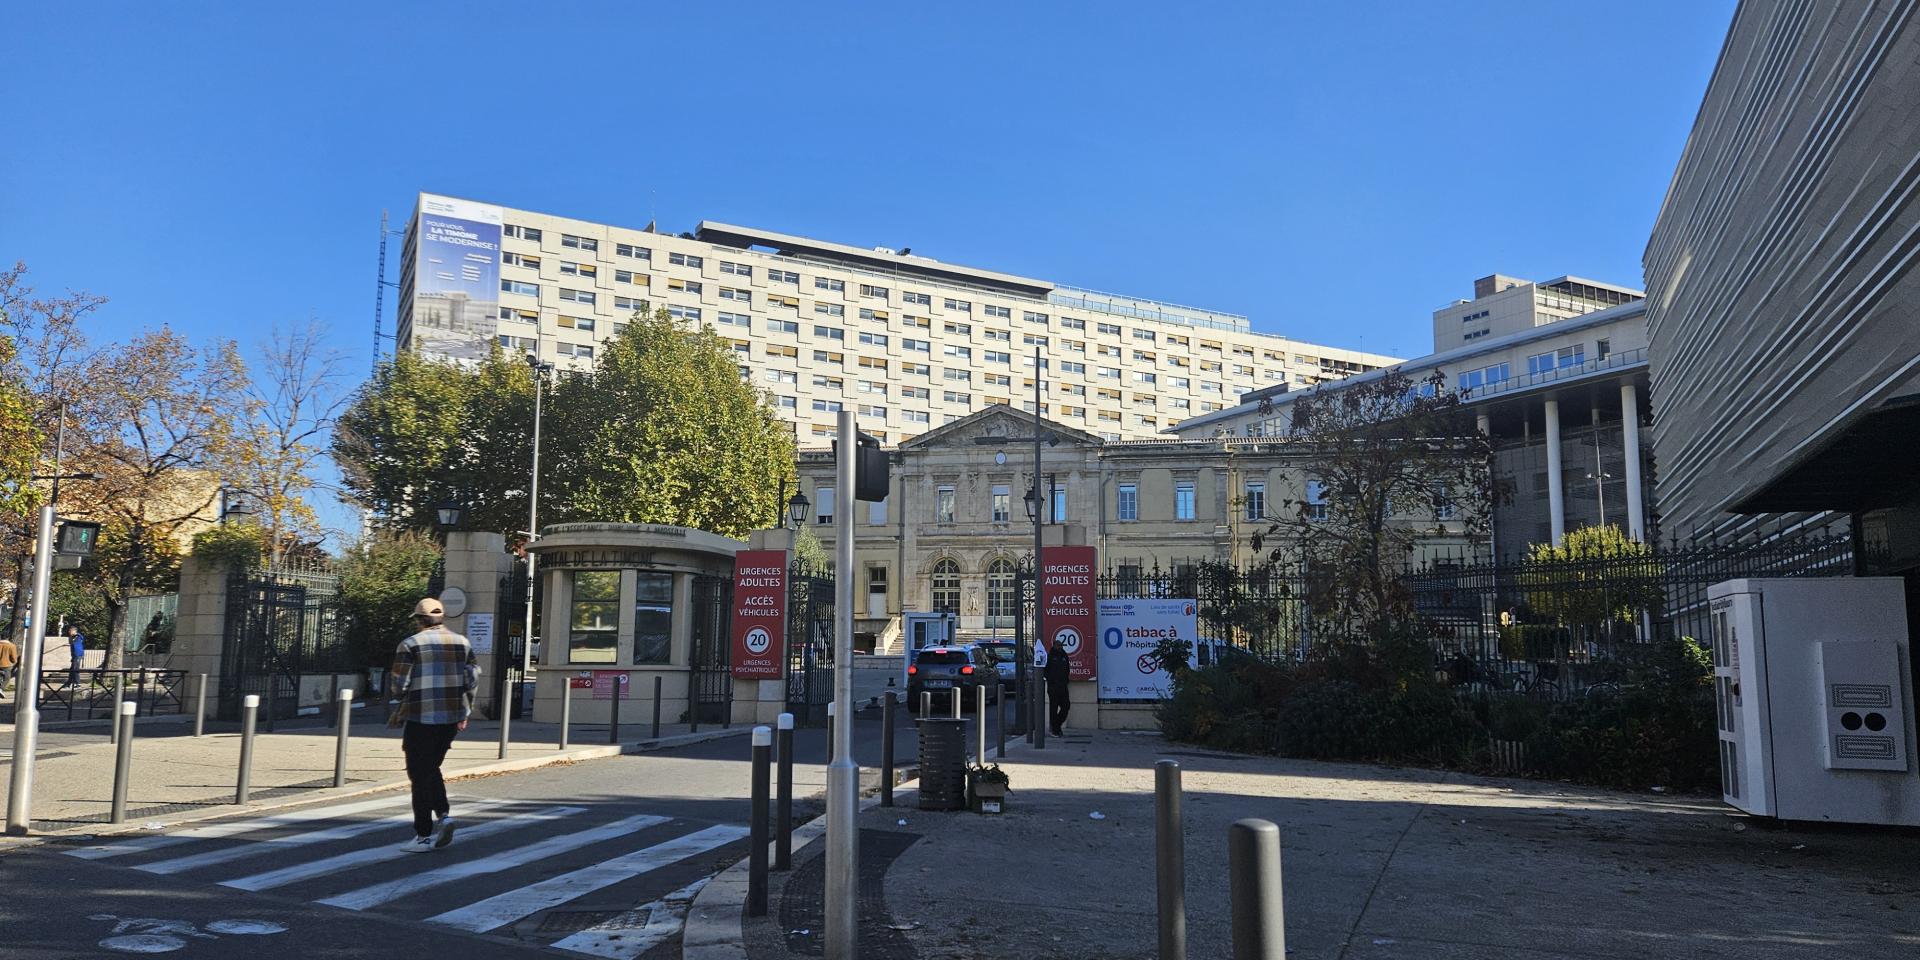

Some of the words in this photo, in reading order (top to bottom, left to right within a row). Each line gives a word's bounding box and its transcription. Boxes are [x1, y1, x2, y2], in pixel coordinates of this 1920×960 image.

[444, 229, 479, 240] TIMONE
[426, 233, 438, 241] SE
[439, 235, 494, 250] MODERNISE
[574, 551, 589, 567] DE
[592, 551, 608, 567] LA
[612, 550, 657, 568] TIMONE
[740, 567, 781, 575] URGENCES
[1044, 565, 1090, 573] URGENCES
[739, 578, 781, 587] ADULTES
[1045, 576, 1089, 585] ADULTES
[744, 594, 774, 606] ACCÈS
[1051, 593, 1083, 605] ACCÈS
[738, 607, 779, 617] VÉHICULES
[1045, 606, 1089, 616] VÉHICULES
[1126, 626, 1166, 638] tabac
[1169, 625, 1177, 638] à
[750, 634, 766, 646] 20
[1059, 634, 1076, 647] 20
